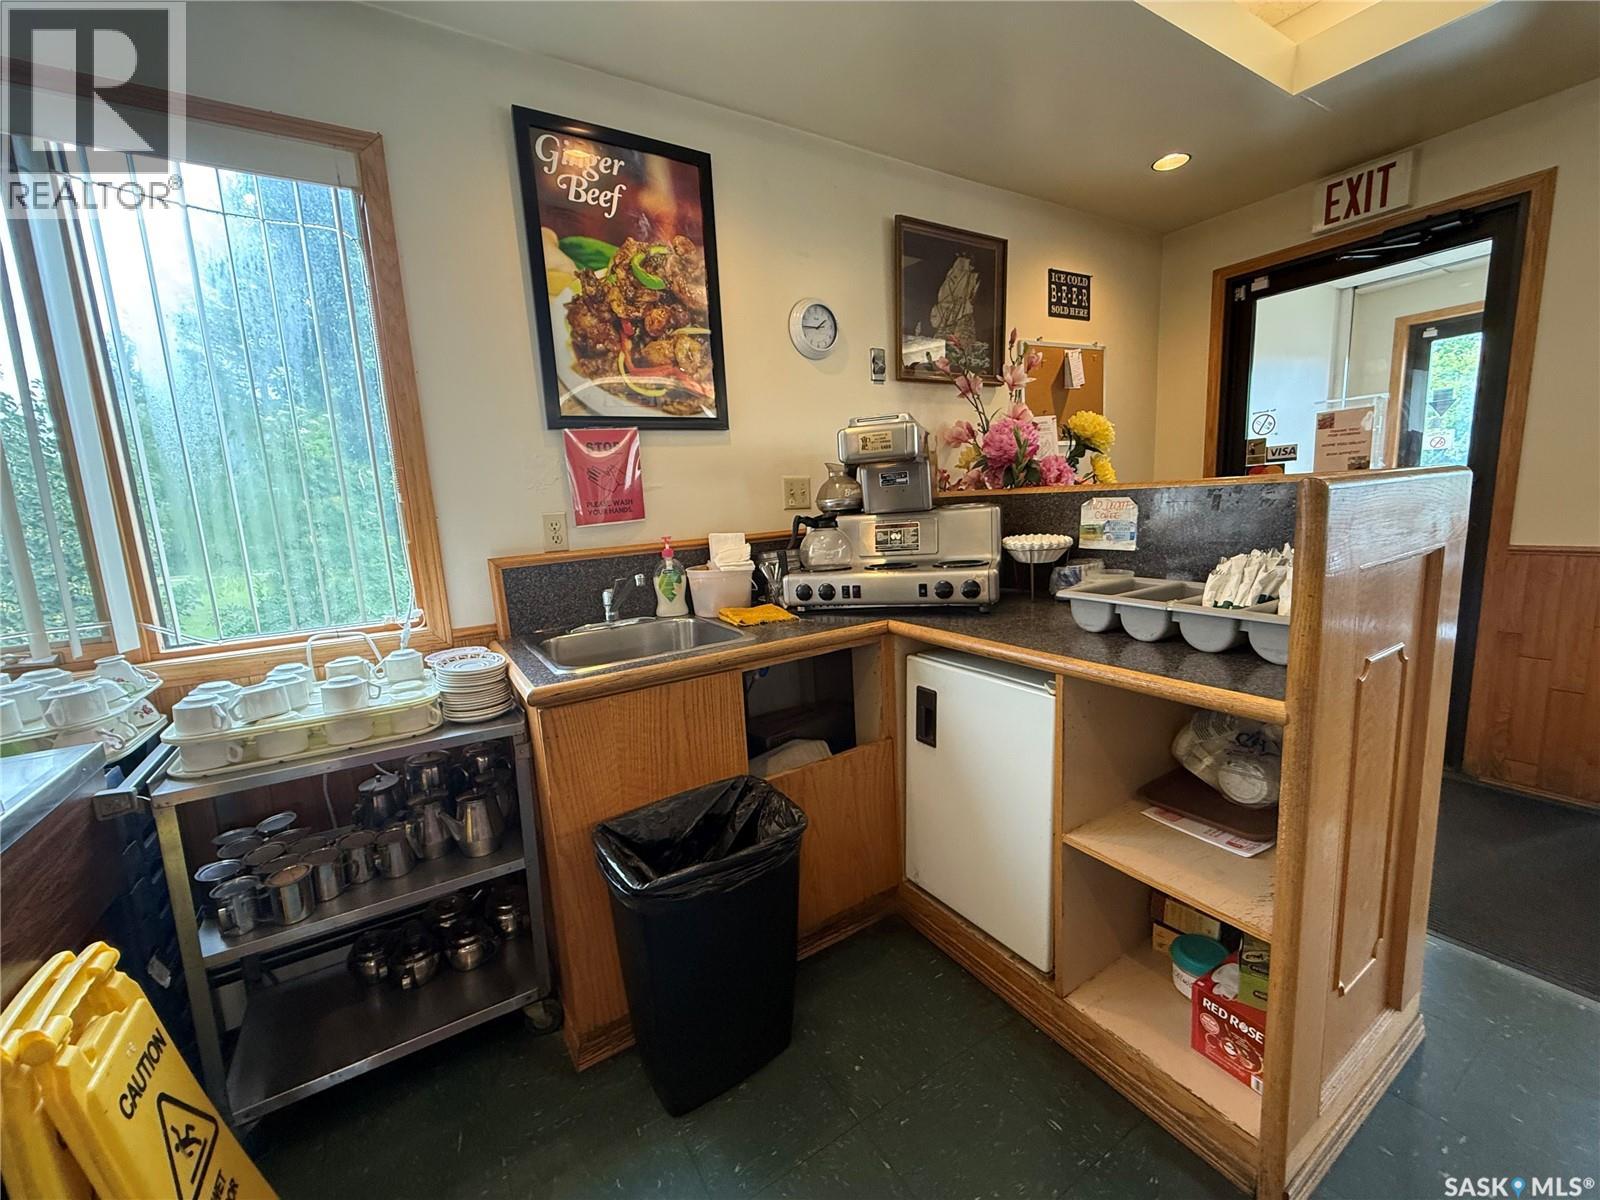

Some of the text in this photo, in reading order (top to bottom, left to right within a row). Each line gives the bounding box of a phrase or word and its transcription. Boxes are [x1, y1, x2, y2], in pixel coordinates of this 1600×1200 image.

[535, 134, 625, 182] Ginger
[557, 173, 627, 219] Beef
[1324, 161, 1397, 226] EXIT
[1051, 272, 1088, 286] ICE COLD
[1051, 304, 1088, 317] SOLD HERE
[1270, 446, 1297, 457] VISA
[1202, 997, 1229, 1020] RED
[1229, 1014, 1265, 1045] ROSE
[119, 1027, 167, 1120] CAUTION
